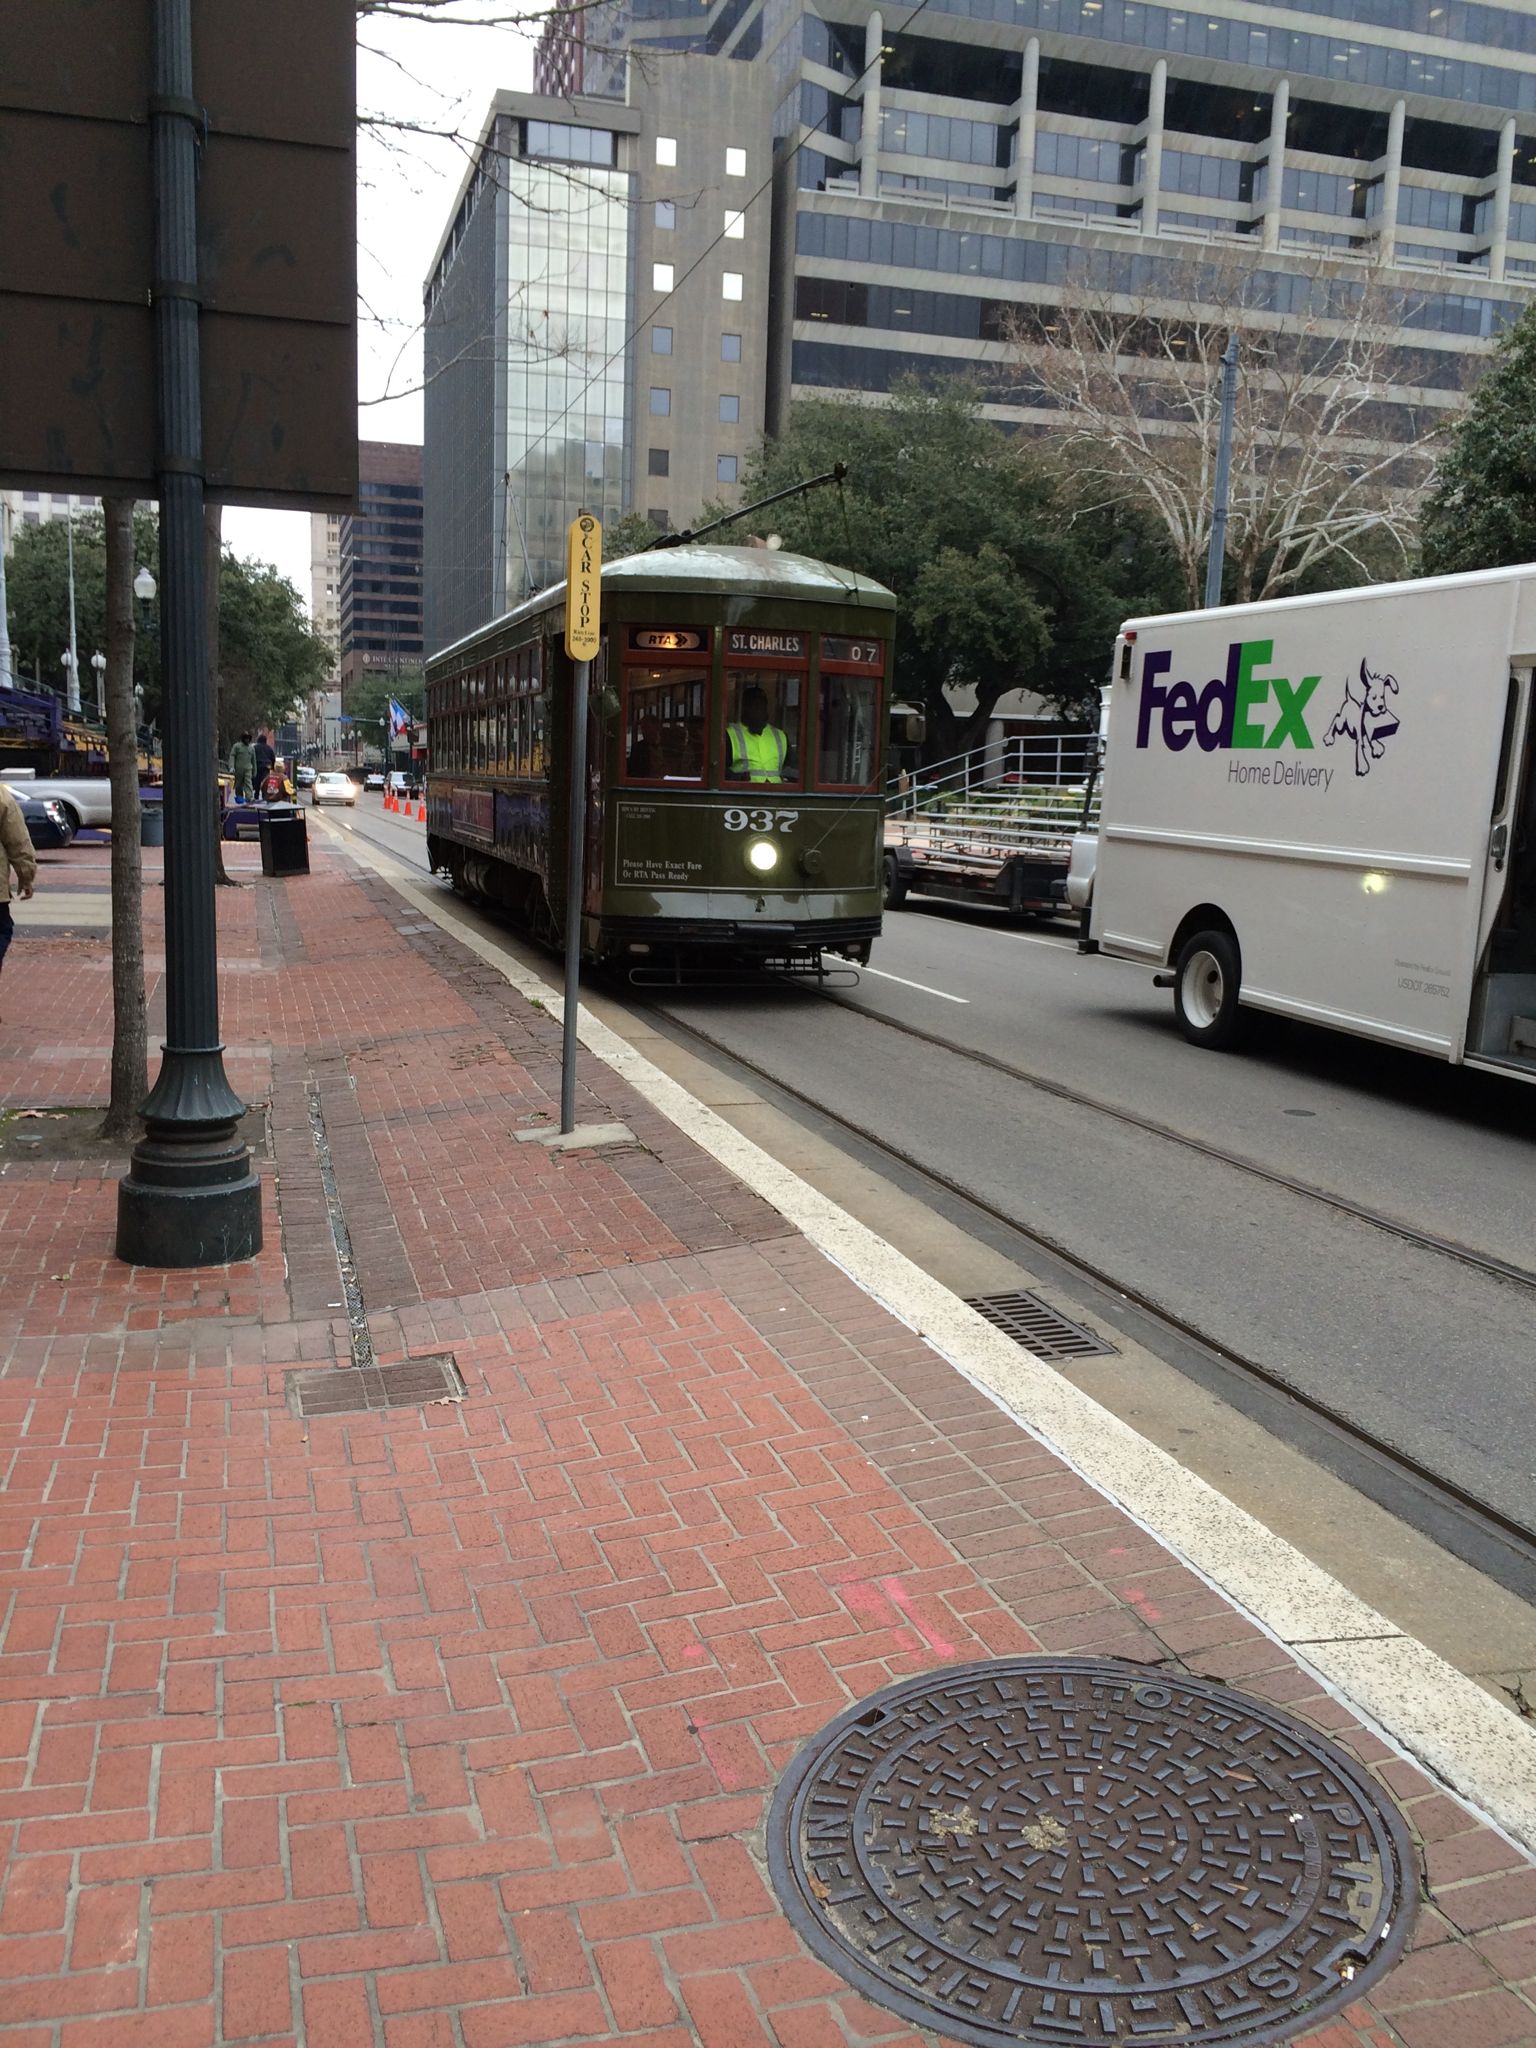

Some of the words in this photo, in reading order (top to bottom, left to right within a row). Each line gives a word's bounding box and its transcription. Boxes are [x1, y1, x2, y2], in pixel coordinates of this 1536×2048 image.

[581, 536, 593, 574] CAR
[580, 580, 591, 628] STOP
[648, 635, 672, 645] RTA
[732, 634, 748, 649] ST.
[749, 635, 800, 651] CHARLES
[1136, 639, 1323, 753] FedEx
[1228, 760, 1271, 784] Home
[1273, 761, 1334, 792] Delivery
[723, 809, 799, 833] 937
[622, 859, 644, 868] Please
[646, 860, 663, 869] Have
[665, 861, 685, 870] Exact
[687, 861, 702, 870] Fare
[634, 870, 649, 879] RTA
[651, 871, 666, 880] Pass
[668, 872, 689, 881] Ready
